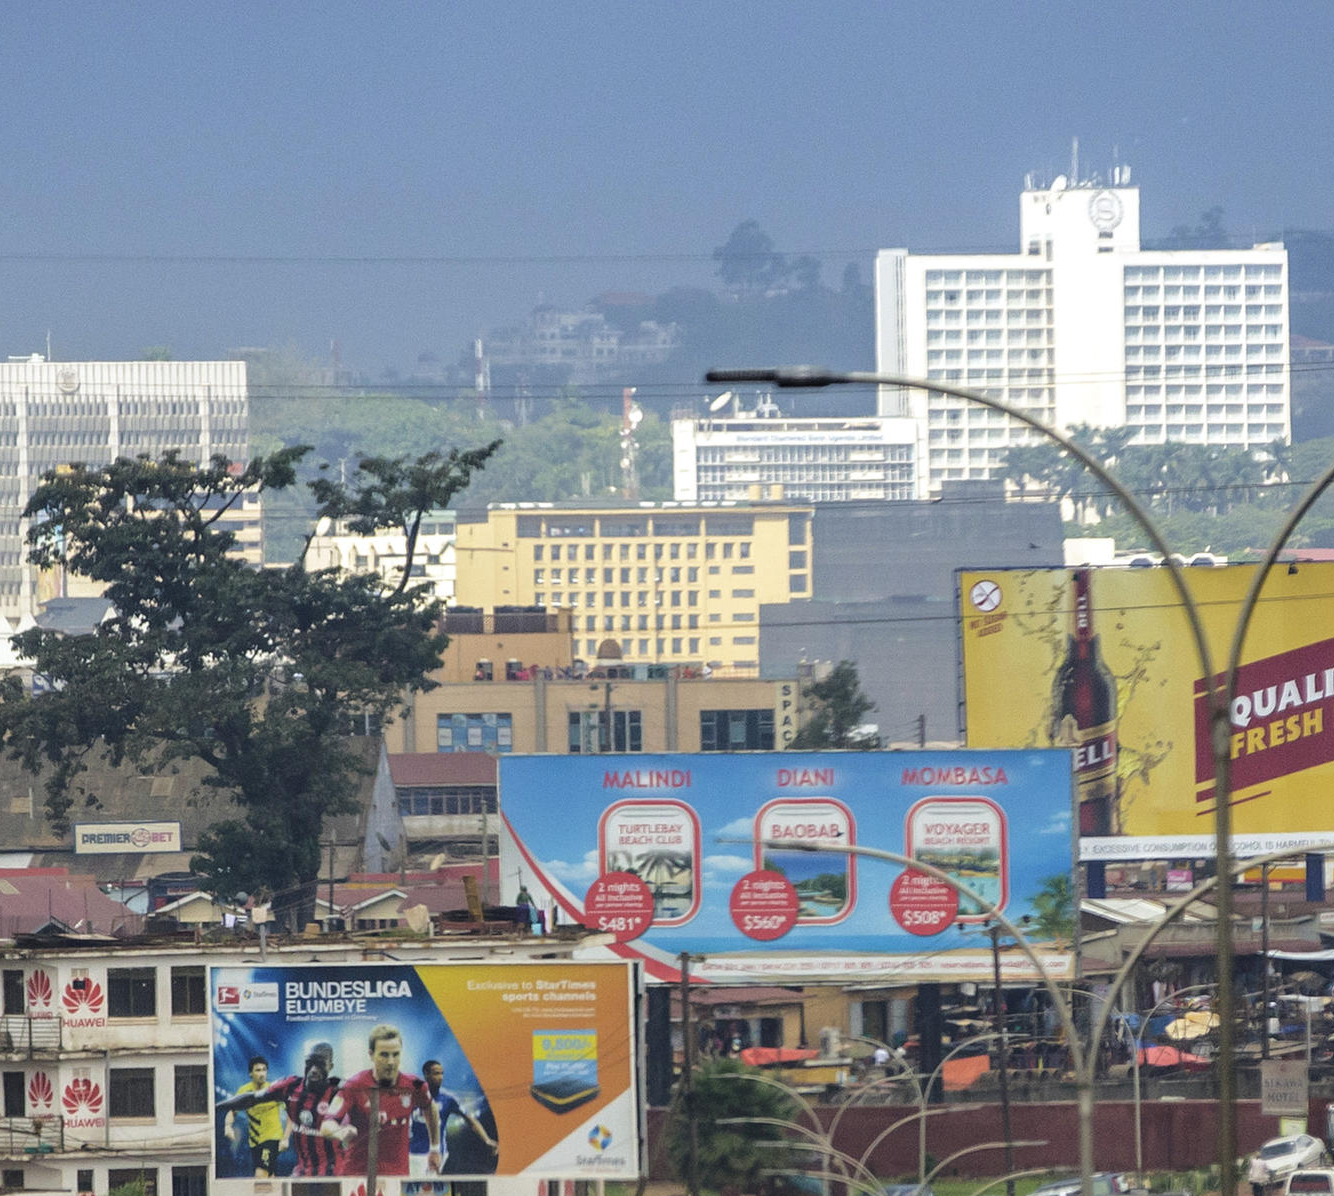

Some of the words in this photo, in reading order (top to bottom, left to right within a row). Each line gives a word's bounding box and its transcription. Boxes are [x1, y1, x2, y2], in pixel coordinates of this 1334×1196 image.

[1228, 707, 1324, 761] FRESH
[1073, 740, 1114, 771] ELL
[603, 769, 692, 789] MALINDI
[777, 768, 835, 788] DIANI
[900, 767, 1009, 786] MOMBASA
[619, 824, 683, 836] TURTLEBAY
[771, 824, 840, 839] BAOBAB
[924, 822, 990, 836] VOYAGER
[82, 832, 131, 844] PREMIER
[152, 831, 174, 843] BET
[598, 882, 605, 893] 2
[285, 979, 412, 1000] BUNDESLIGA
[467, 979, 518, 991] Exclusive
[521, 980, 532, 991] to
[535, 979, 596, 991] StarTimes
[502, 991, 539, 1003] sports
[542, 991, 596, 1002] channels
[285, 999, 367, 1015] ELUMBYE
[63, 1018, 106, 1028] HUAWEI
[63, 1118, 106, 1129] HUAWEI
[576, 1154, 627, 1167] StarTimes
